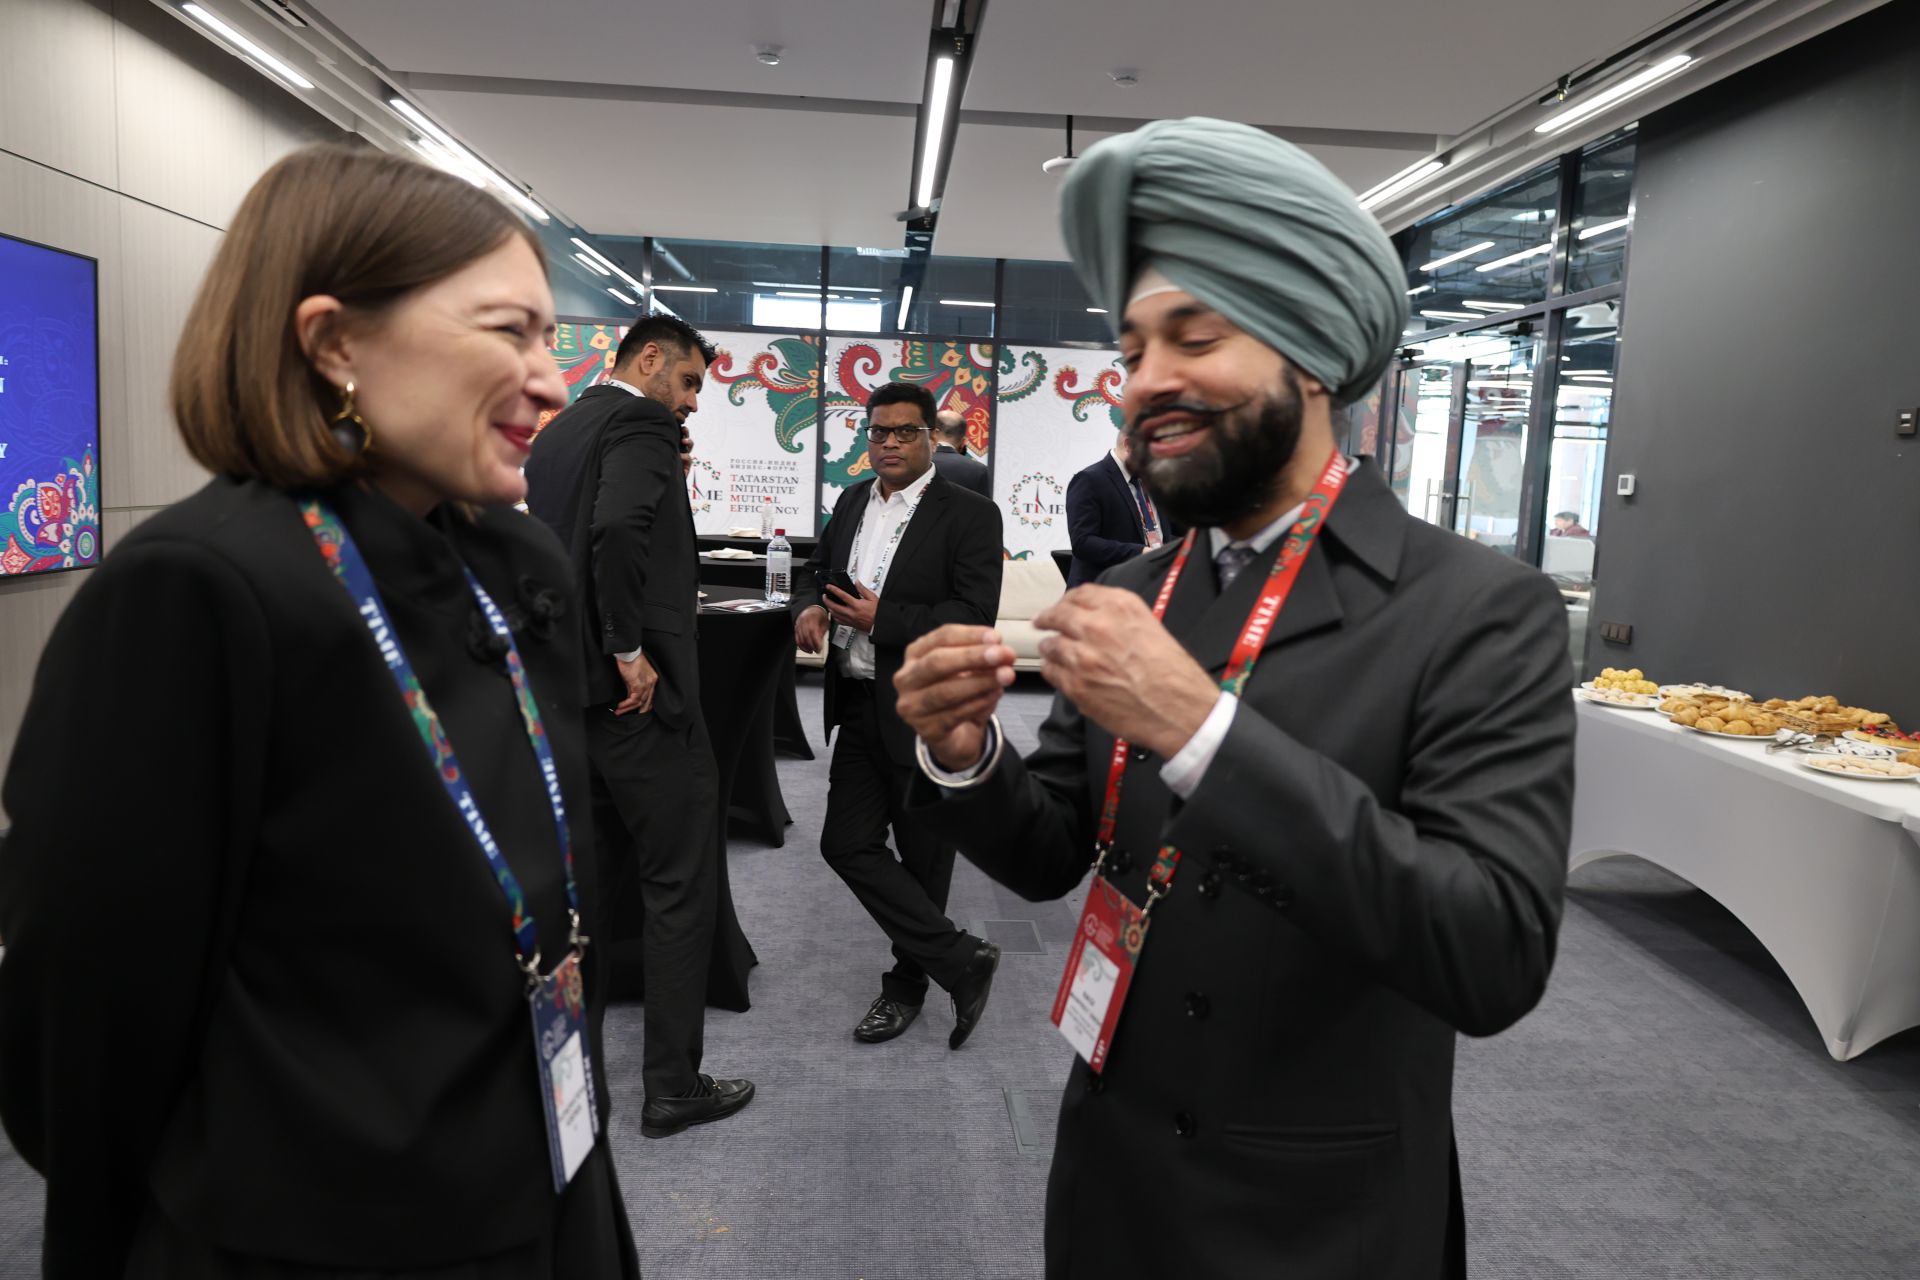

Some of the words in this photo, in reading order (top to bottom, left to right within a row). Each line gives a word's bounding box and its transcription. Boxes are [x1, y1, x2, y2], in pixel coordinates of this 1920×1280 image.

[1322, 453, 1347, 488] IME
[730, 474, 799, 485] TATARSTAN
[687, 488, 723, 501] IME
[730, 484, 796, 494] INITIATIVE
[730, 504, 799, 515] EFFICNCY
[1022, 503, 1064, 514] TIME
[1242, 595, 1281, 648] TIME
[359, 597, 403, 670] TIME
[458, 791, 499, 860] TIME
